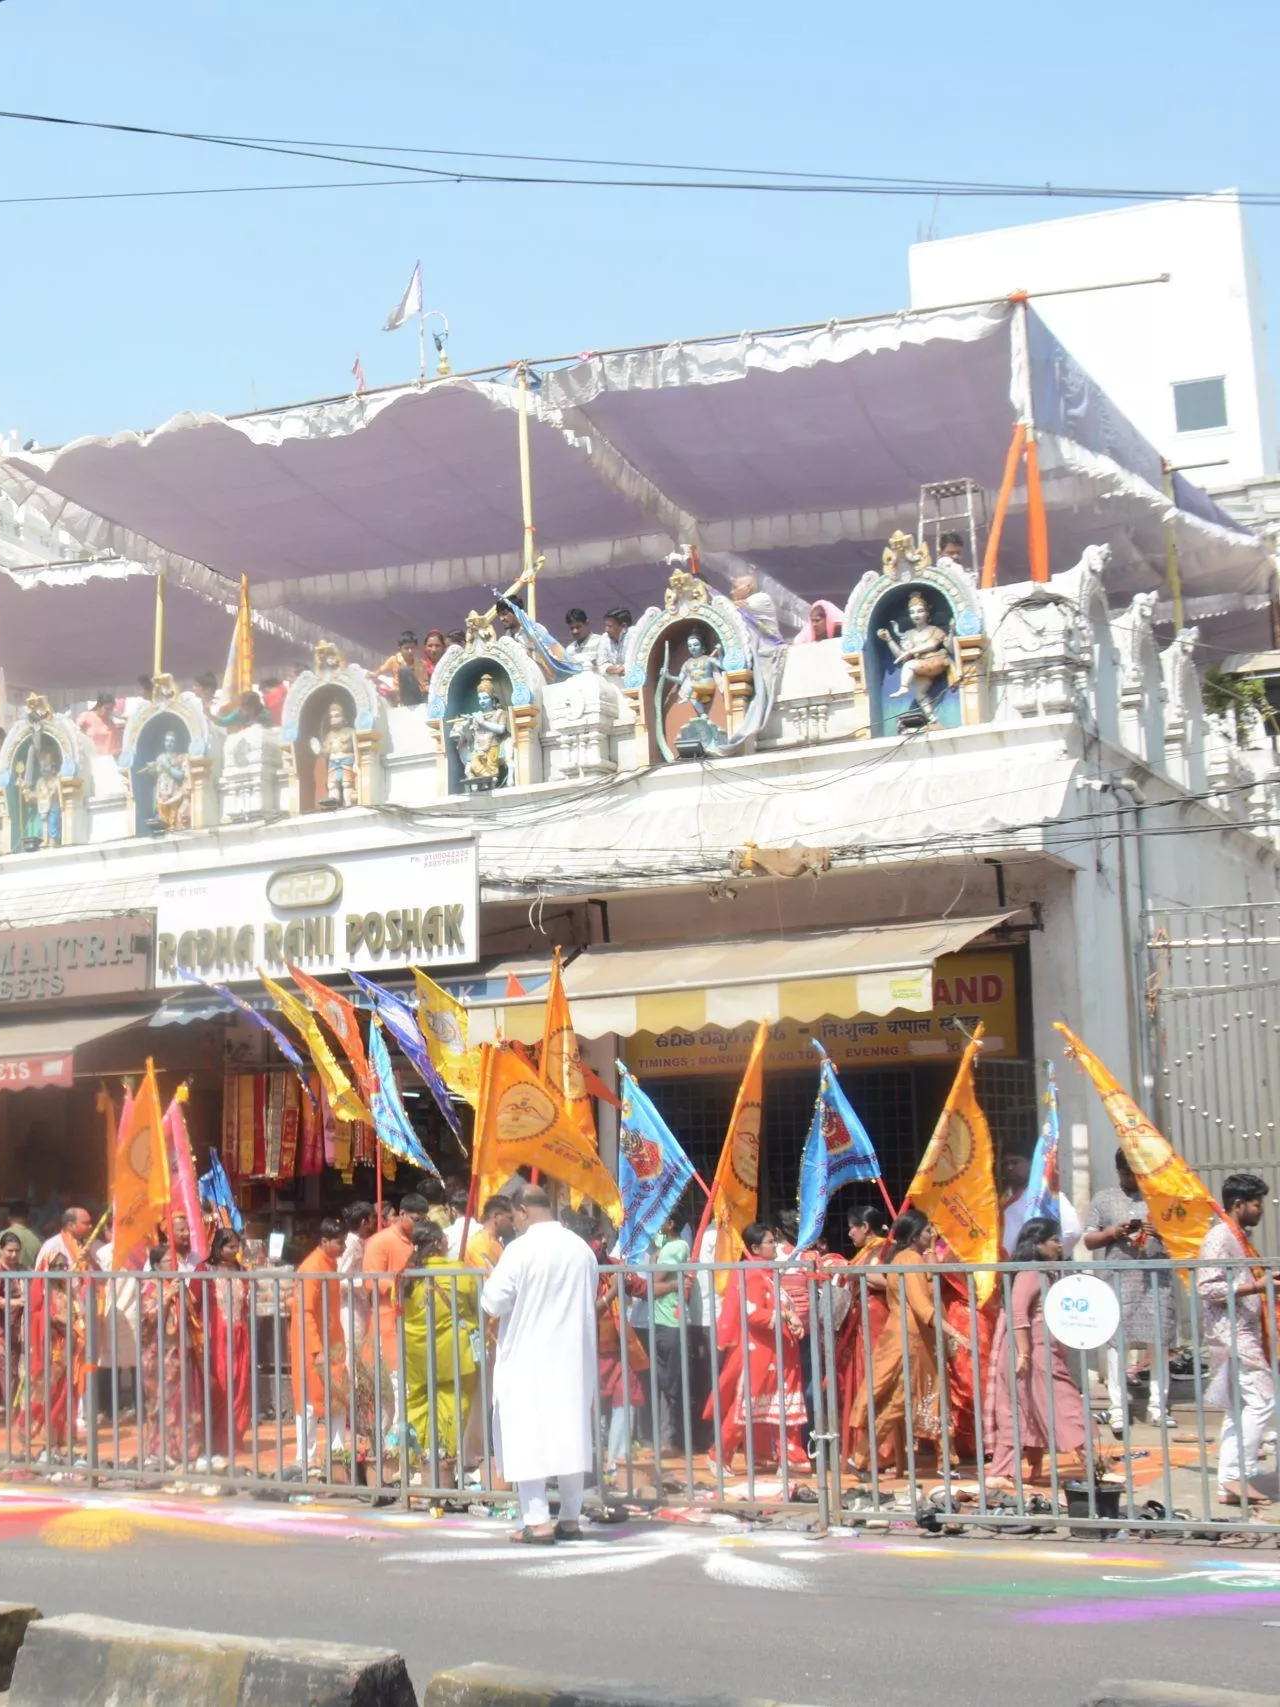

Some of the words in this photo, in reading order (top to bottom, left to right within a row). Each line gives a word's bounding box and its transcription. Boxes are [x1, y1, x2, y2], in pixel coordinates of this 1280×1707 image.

[159, 924, 255, 972] RADHA
[263, 915, 336, 962] RANI
[346, 903, 465, 955] POSHAK
[933, 974, 1003, 1006] AND
[638, 1057, 688, 1069] TIMINGS
[699, 1054, 750, 1066] MORNI
[846, 1045, 899, 1057] EVENNG
